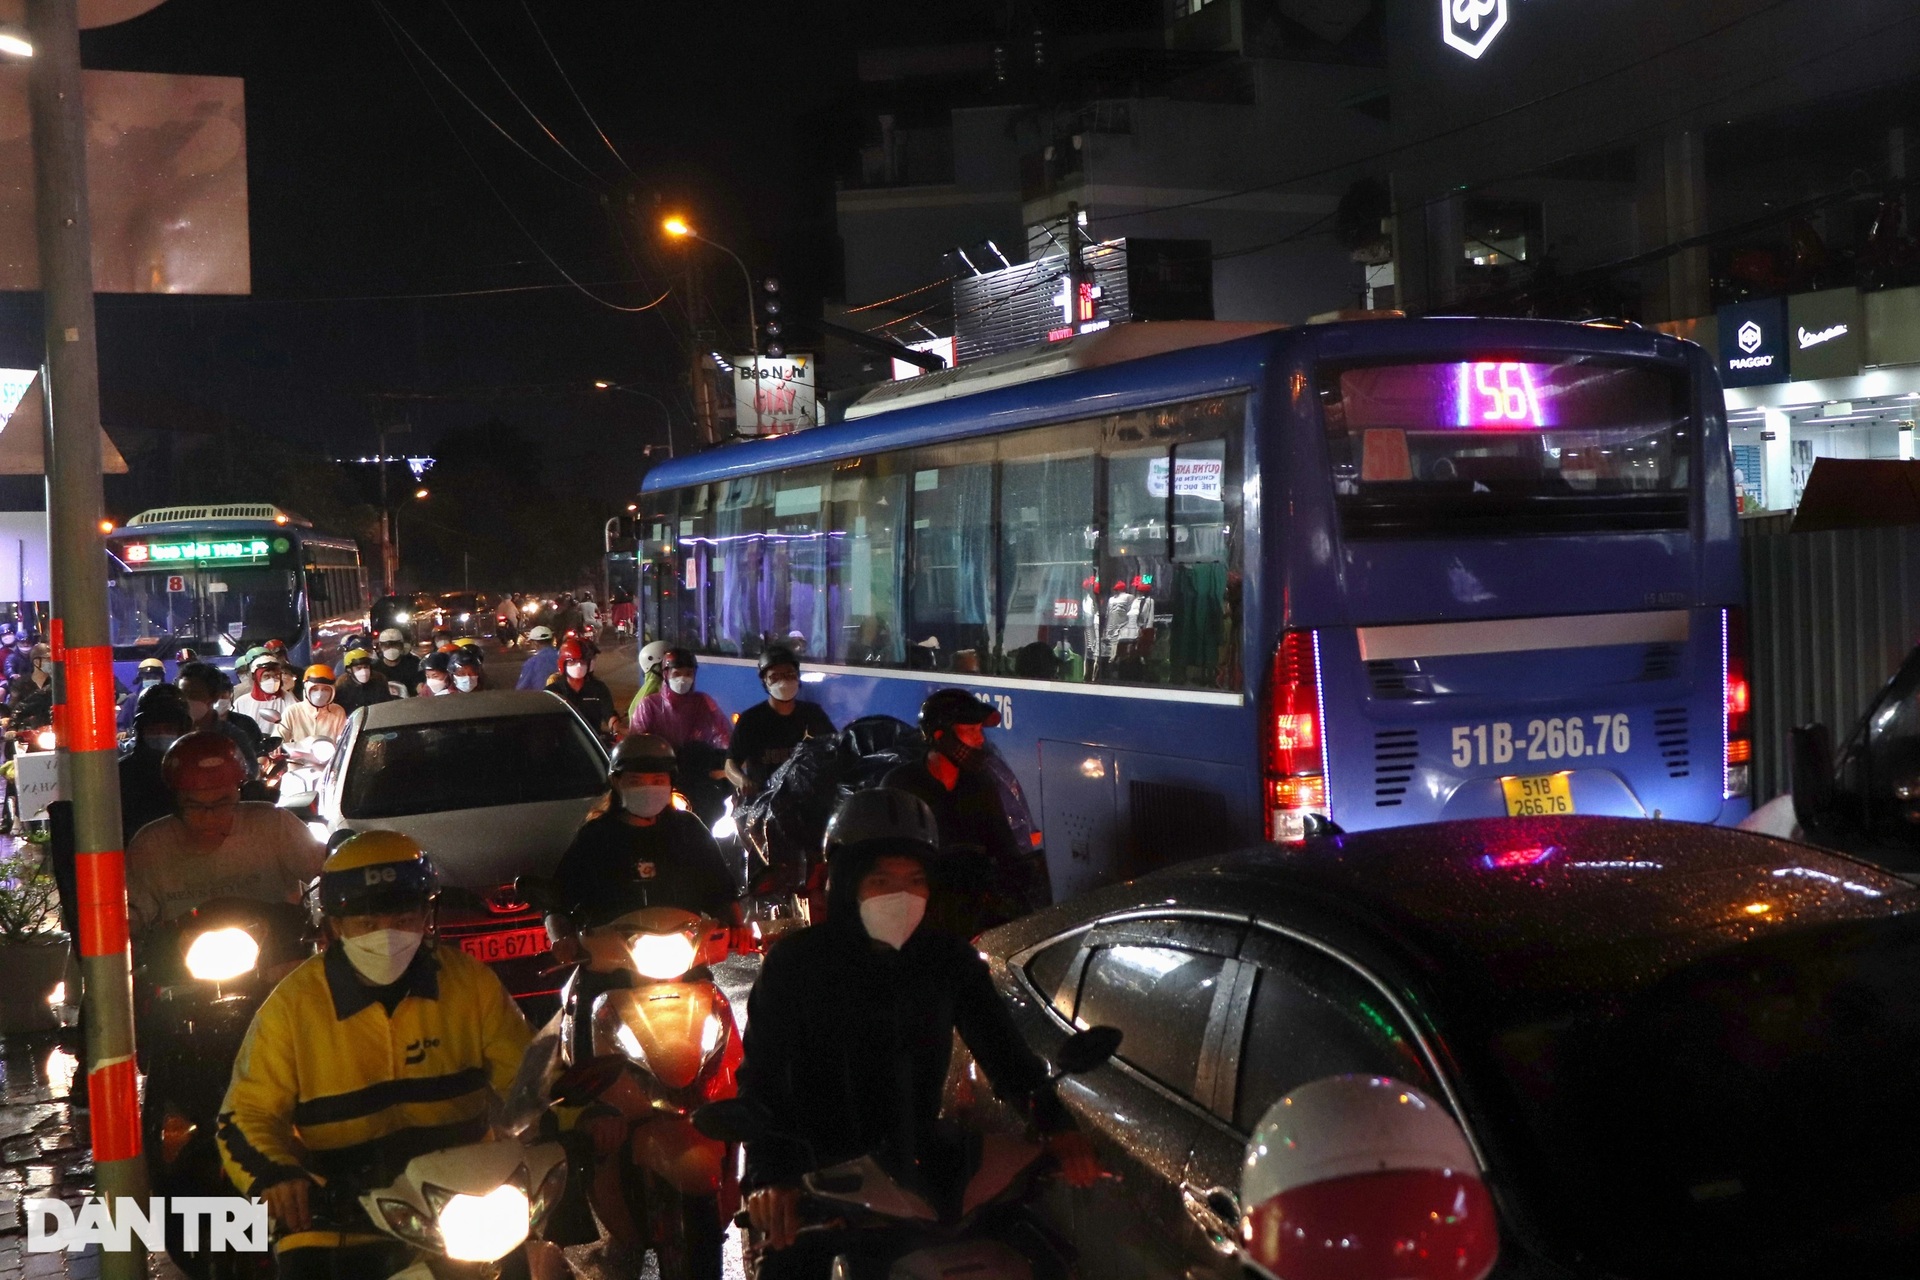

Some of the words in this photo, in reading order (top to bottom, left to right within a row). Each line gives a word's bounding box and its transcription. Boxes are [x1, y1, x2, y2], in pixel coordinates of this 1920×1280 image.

[1798, 325, 1848, 349] Vespa
[1730, 356, 1773, 370] PIAGGIO
[1476, 362, 1526, 420] 56
[169, 576, 183, 591] 8
[1451, 713, 1631, 769] 51B-266.76
[1521, 778, 1551, 797] 51B
[1514, 795, 1567, 817] 266.76
[365, 867, 397, 886] be
[463, 932, 552, 961] 51G-671.6
[423, 1036, 441, 1048] be
